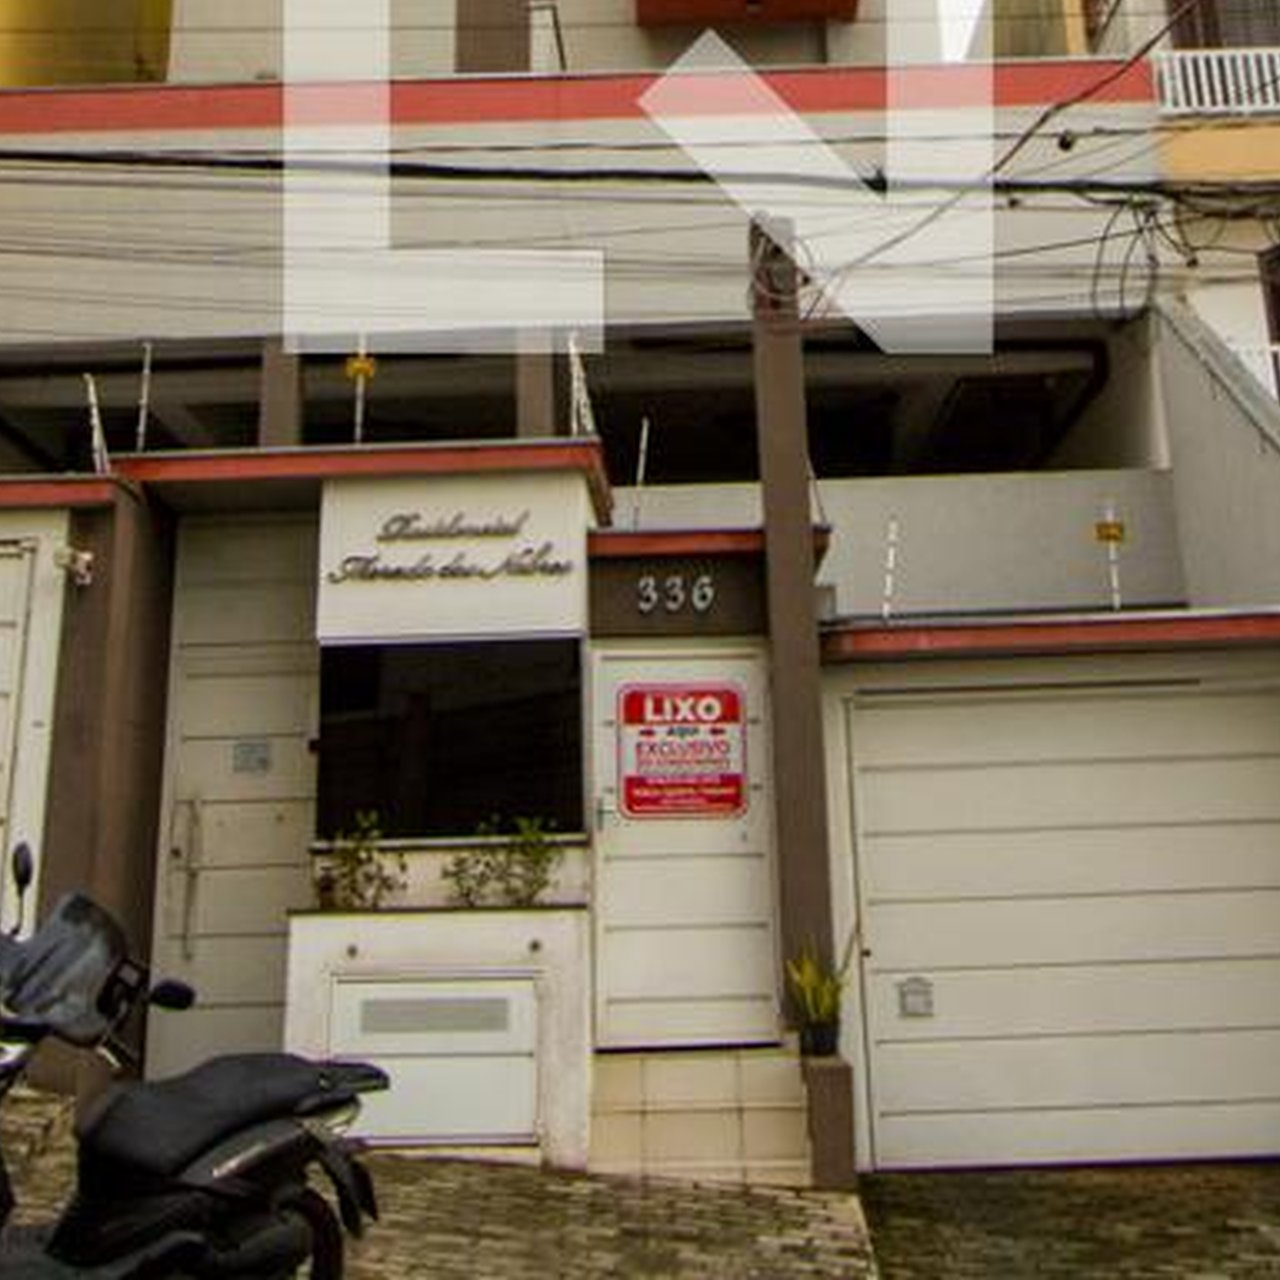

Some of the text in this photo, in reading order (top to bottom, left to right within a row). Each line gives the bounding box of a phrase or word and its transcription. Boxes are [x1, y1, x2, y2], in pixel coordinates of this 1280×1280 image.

[637, 574, 715, 613] 336
[643, 694, 722, 722] LIXO
[635, 740, 731, 757] EXCLUSIVO
